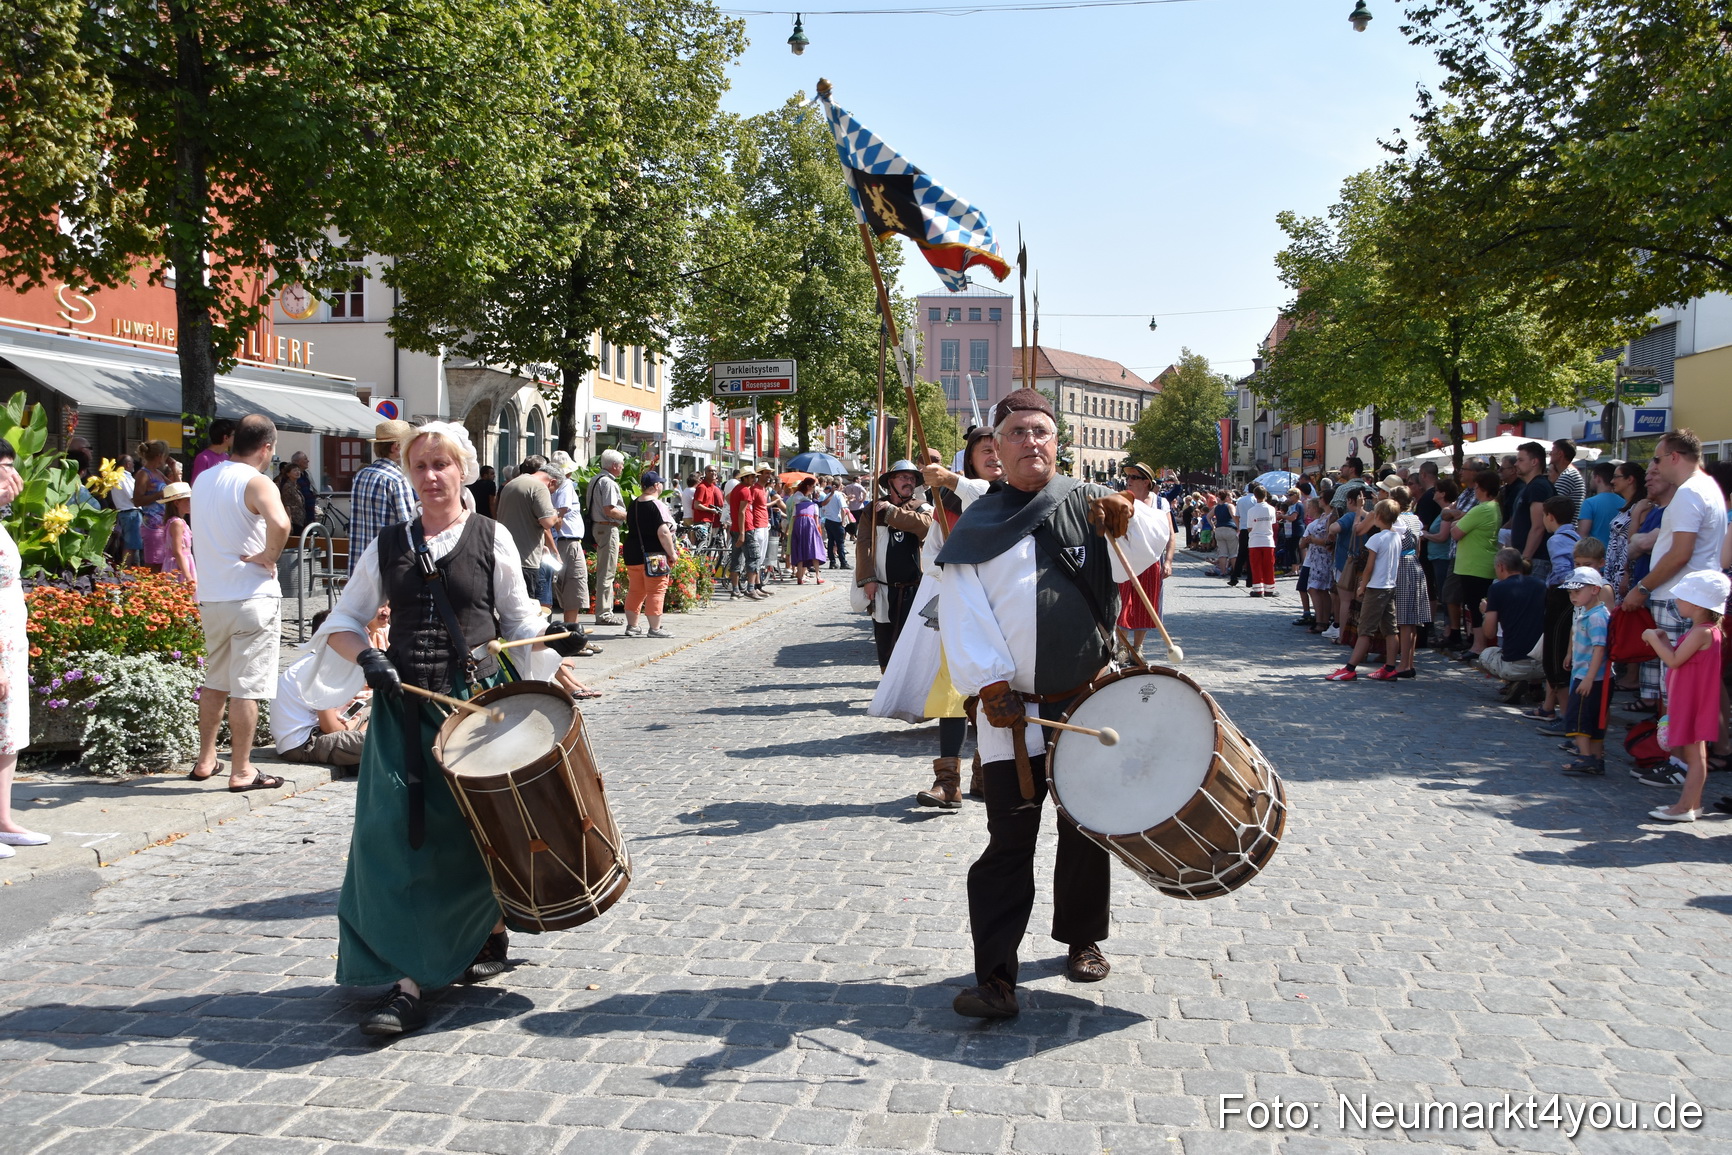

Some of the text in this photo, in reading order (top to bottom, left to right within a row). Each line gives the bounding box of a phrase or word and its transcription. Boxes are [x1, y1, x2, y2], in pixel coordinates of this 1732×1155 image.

[113, 318, 176, 341] juwelie
[726, 364, 780, 376] Parkleitsystem
[1624, 367, 1655, 375] Viehmarkt
[745, 380, 781, 390] Rosengasse
[1637, 415, 1664, 424] APOLLO
